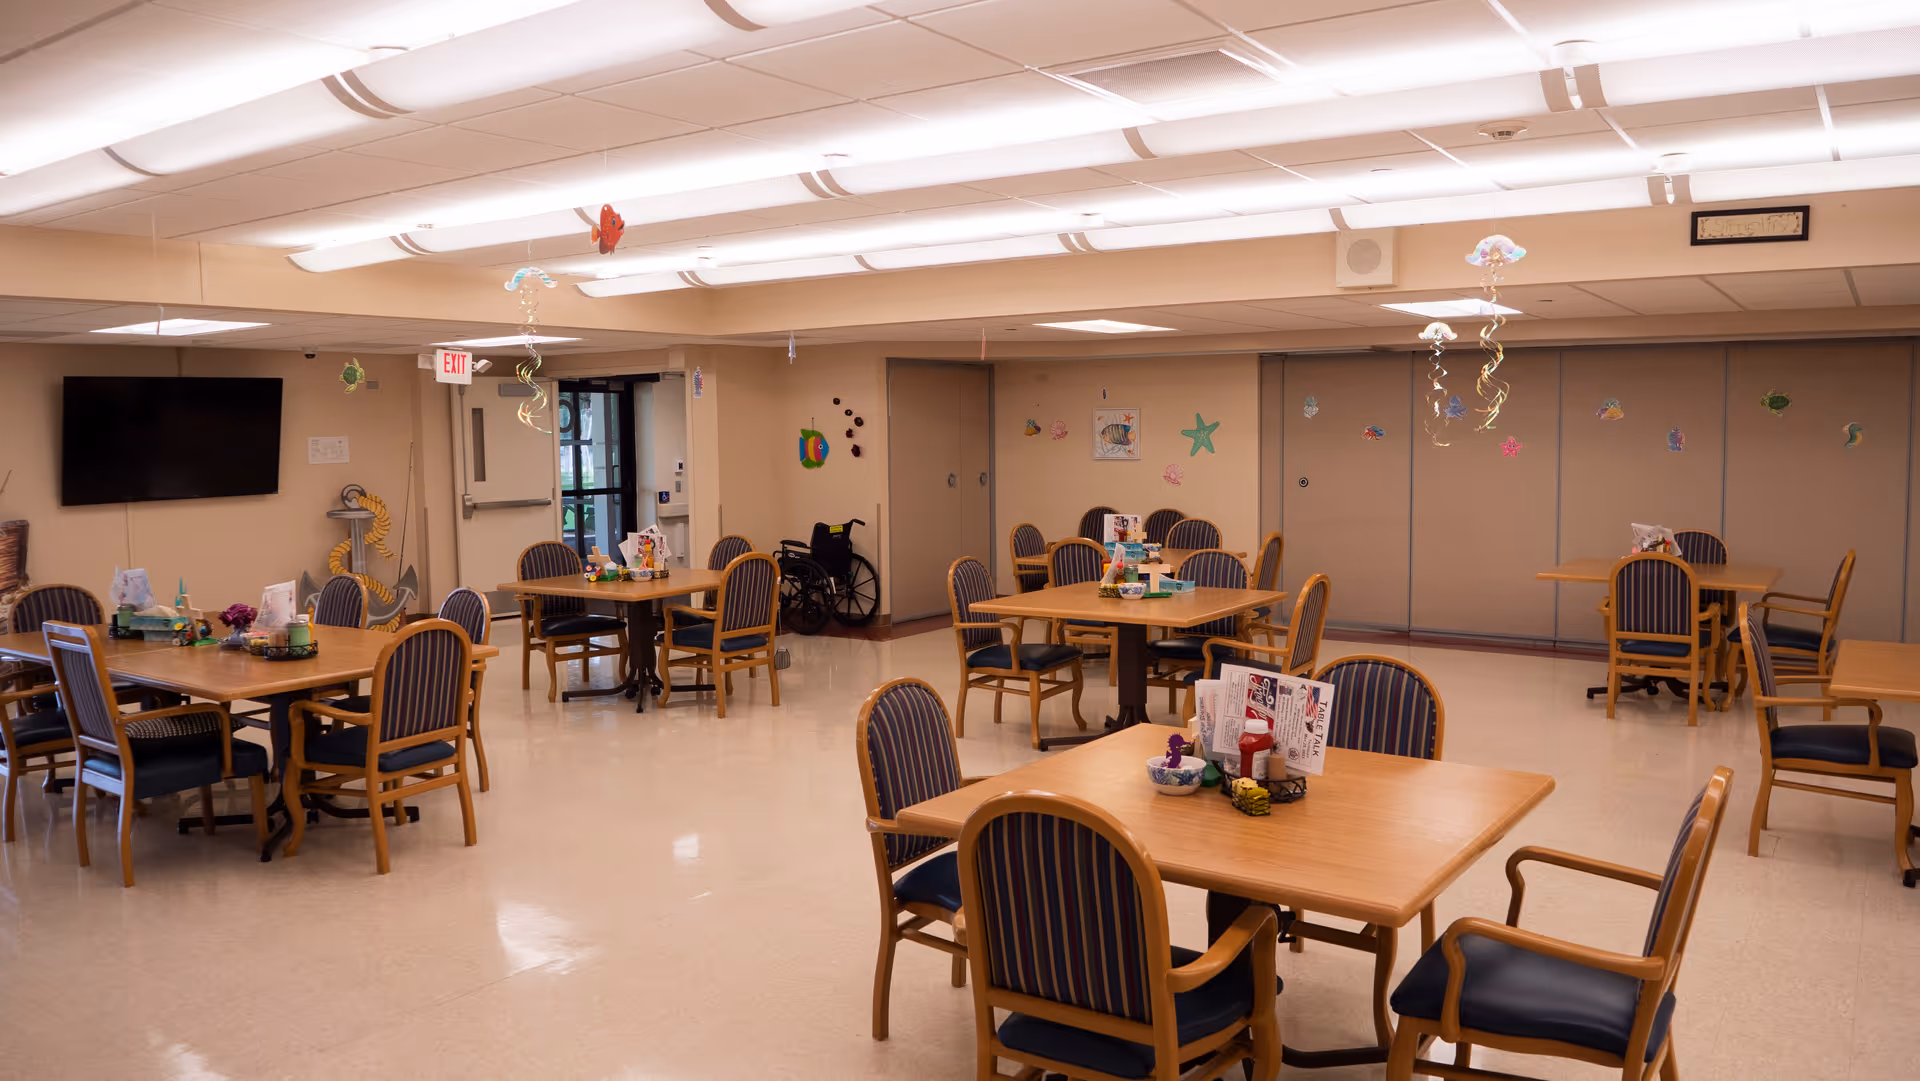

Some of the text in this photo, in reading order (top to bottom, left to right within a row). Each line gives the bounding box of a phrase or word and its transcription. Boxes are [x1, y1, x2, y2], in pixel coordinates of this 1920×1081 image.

[444, 352, 466, 374] EXIT
[1312, 701, 1328, 757] TABLE TALK
